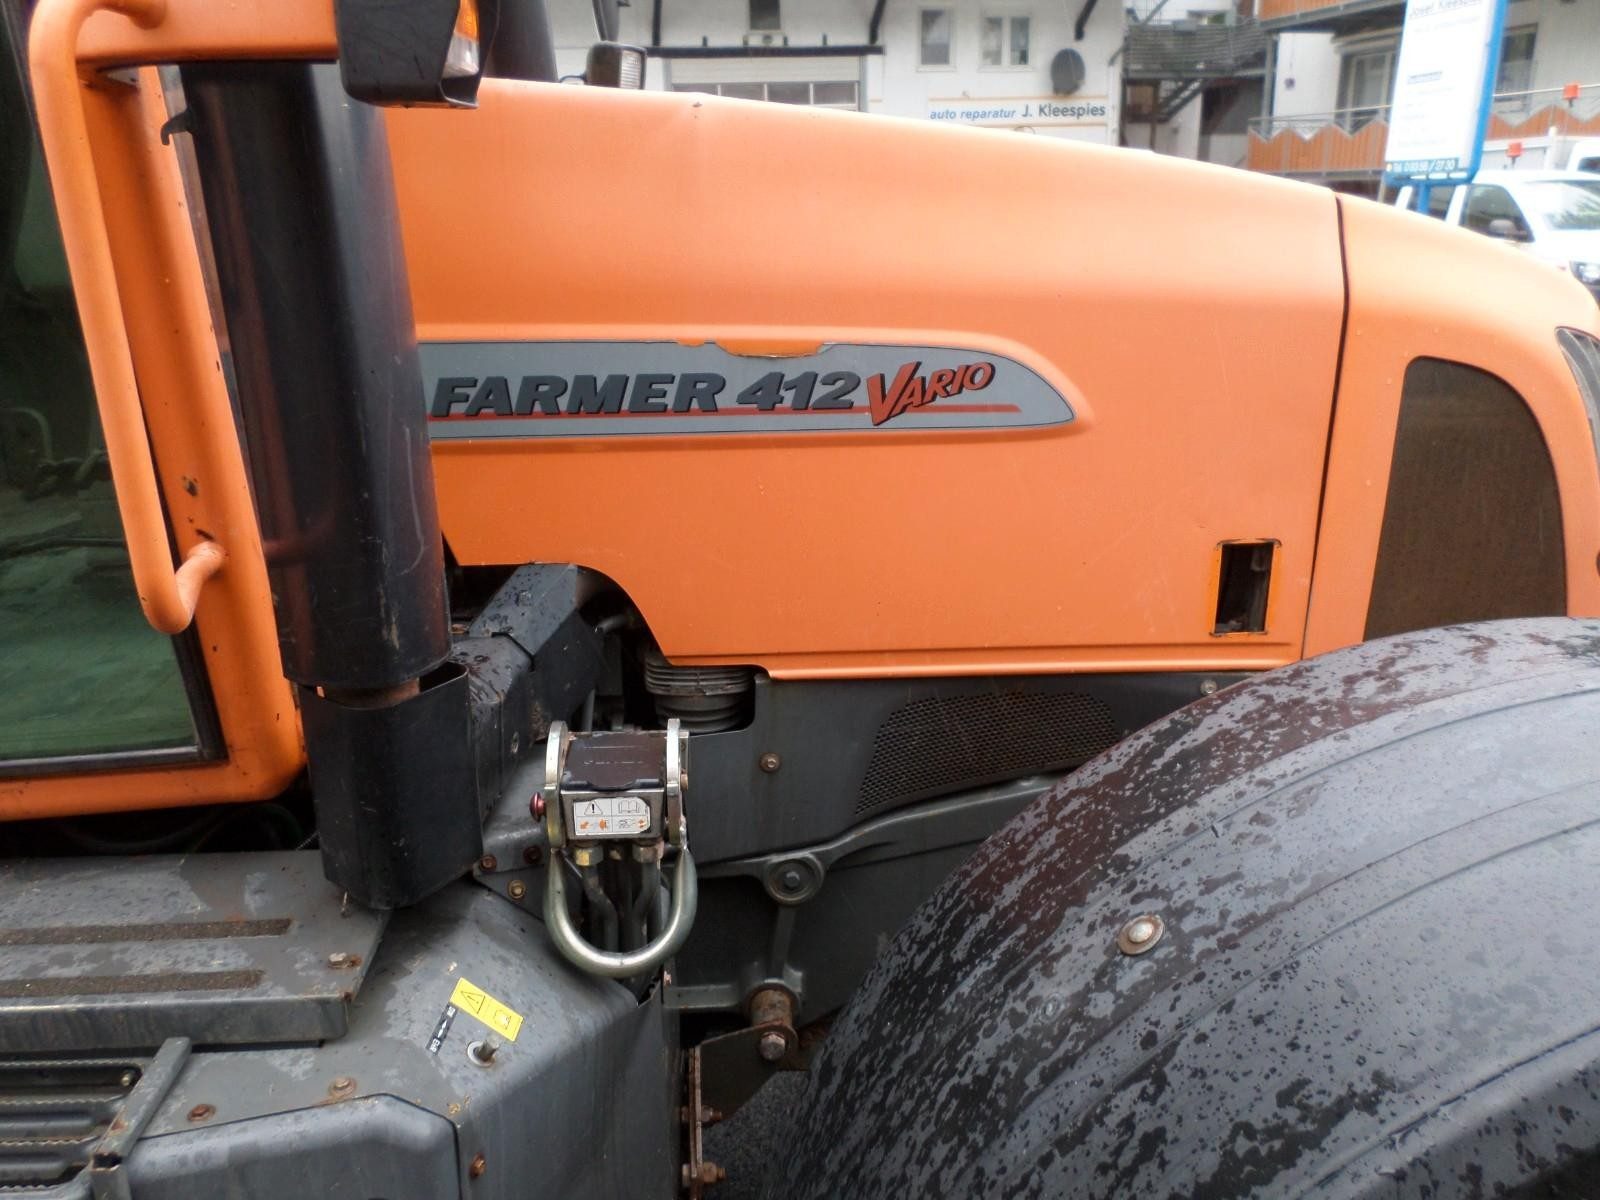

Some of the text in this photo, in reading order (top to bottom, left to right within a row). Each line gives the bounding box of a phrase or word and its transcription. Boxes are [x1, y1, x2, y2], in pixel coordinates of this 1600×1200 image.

[929, 102, 1107, 121] auto reparatur J. Kleespies
[431, 361, 996, 427] FARMER 412 VARIO
